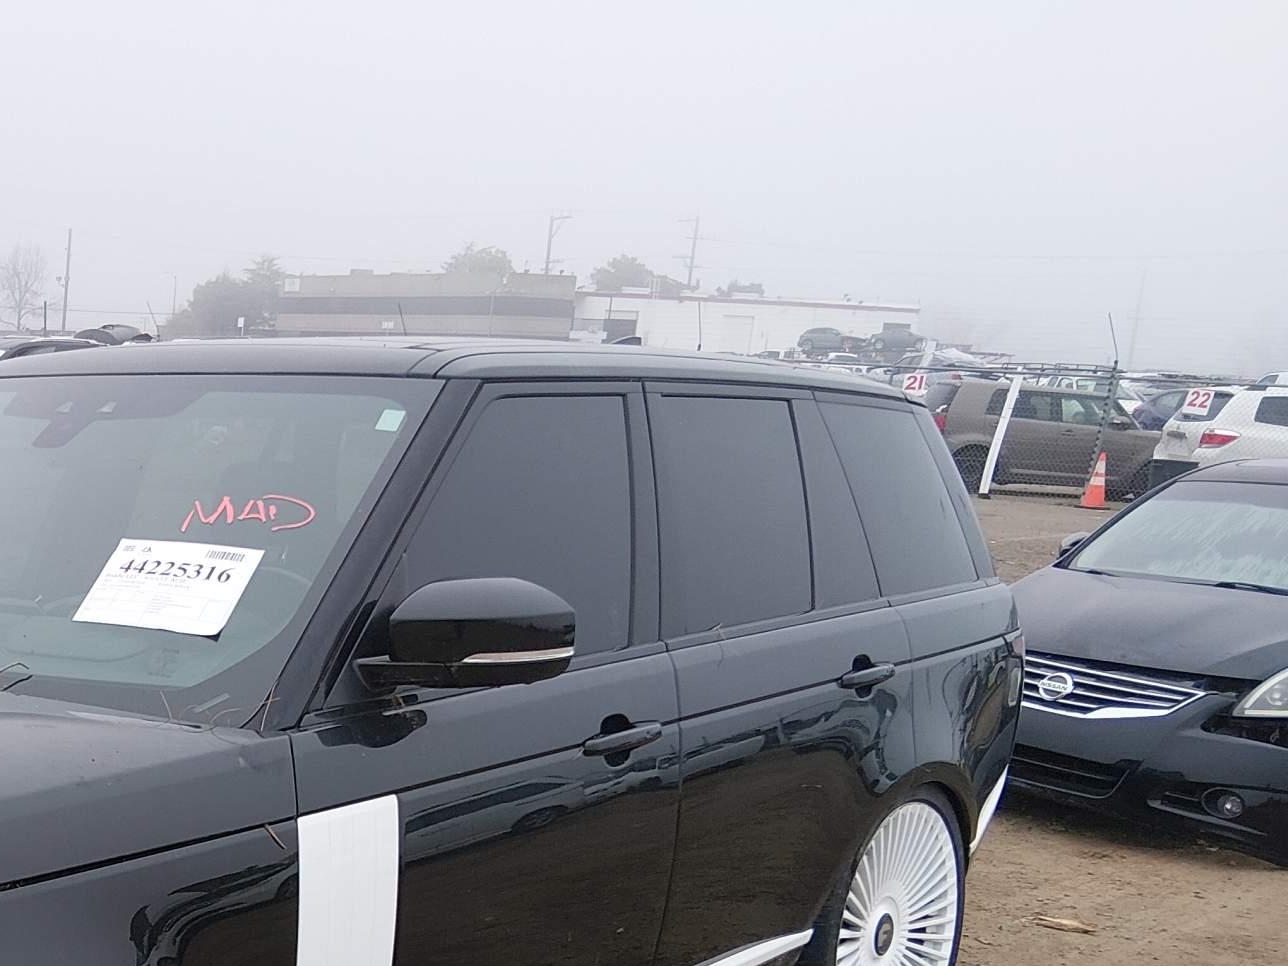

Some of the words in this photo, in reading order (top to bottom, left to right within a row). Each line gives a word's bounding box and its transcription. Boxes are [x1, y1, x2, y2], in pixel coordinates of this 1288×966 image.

[904, 375, 925, 391] 21
[1187, 390, 1211, 409] 22
[119, 559, 236, 584] 44225316
